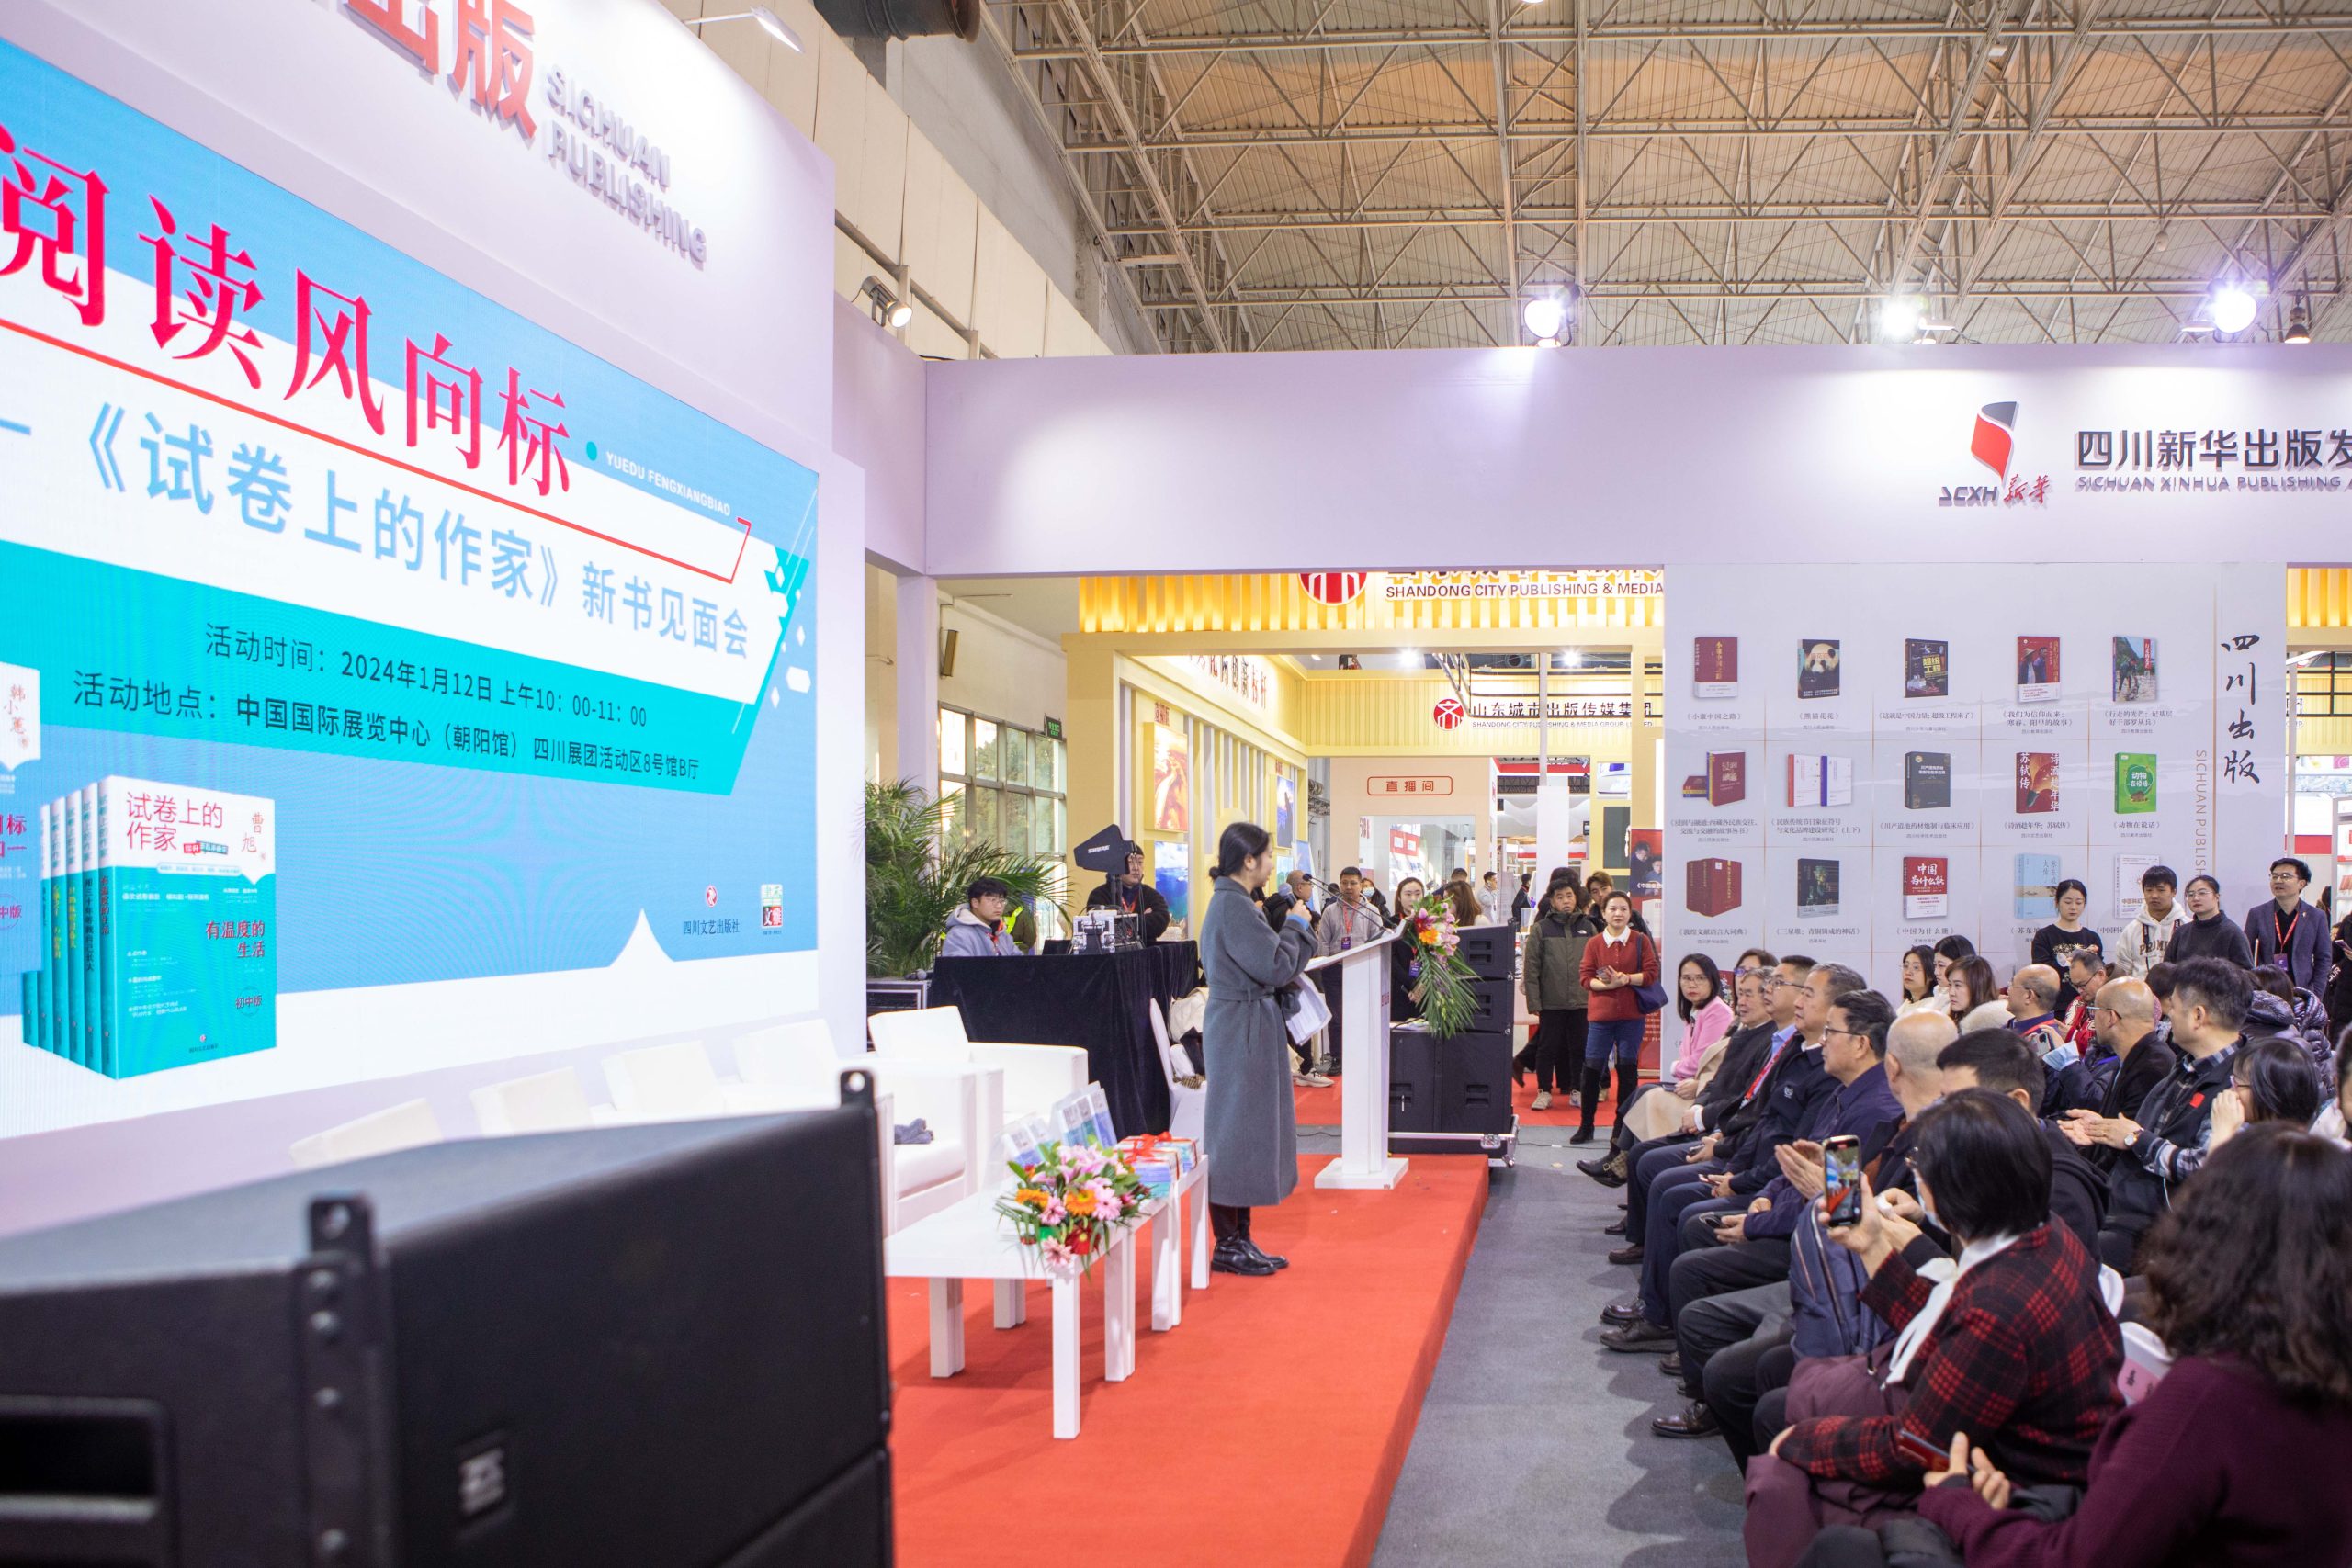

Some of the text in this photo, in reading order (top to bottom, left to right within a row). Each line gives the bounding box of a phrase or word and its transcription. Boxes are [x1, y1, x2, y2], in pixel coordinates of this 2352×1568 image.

[546, 64, 671, 190] SICHUAN
[547, 119, 707, 263] PUBLISHING
[0, 123, 571, 498] 阅读风向标
[2078, 428, 2352, 468] 四川新华出版发
[605, 451, 731, 517] YUEDU FENGXIANGBIAO
[2078, 475, 2155, 489] SICHUAN
[2160, 475, 2230, 489] XINHUA
[2237, 476, 2342, 488] PUBLISHING
[1385, 582, 1664, 598] SHANDONG CITY PUBLISHING & MEDIA
[582, 560, 749, 660] 新书见面会
[2220, 634, 2261, 784] 四川出版
[2019, 752, 2030, 789] 苏轼传
[2131, 771, 2147, 780] 动物
[2195, 750, 2207, 814] SICHUAN
[1385, 780, 1434, 792] 直播间
[127, 791, 223, 829] 试卷上的
[0, 813, 28, 837] 标
[127, 820, 177, 852] 作家
[1087, 843, 1111, 854] SHURE
[1910, 874, 1946, 886] 为什么能
[1917, 863, 1938, 875] 中国
[206, 919, 266, 940] 有温度的
[683, 919, 741, 935] 四川文艺出版社
[236, 940, 266, 958] 生活
[234, 995, 263, 1009] 初中版
